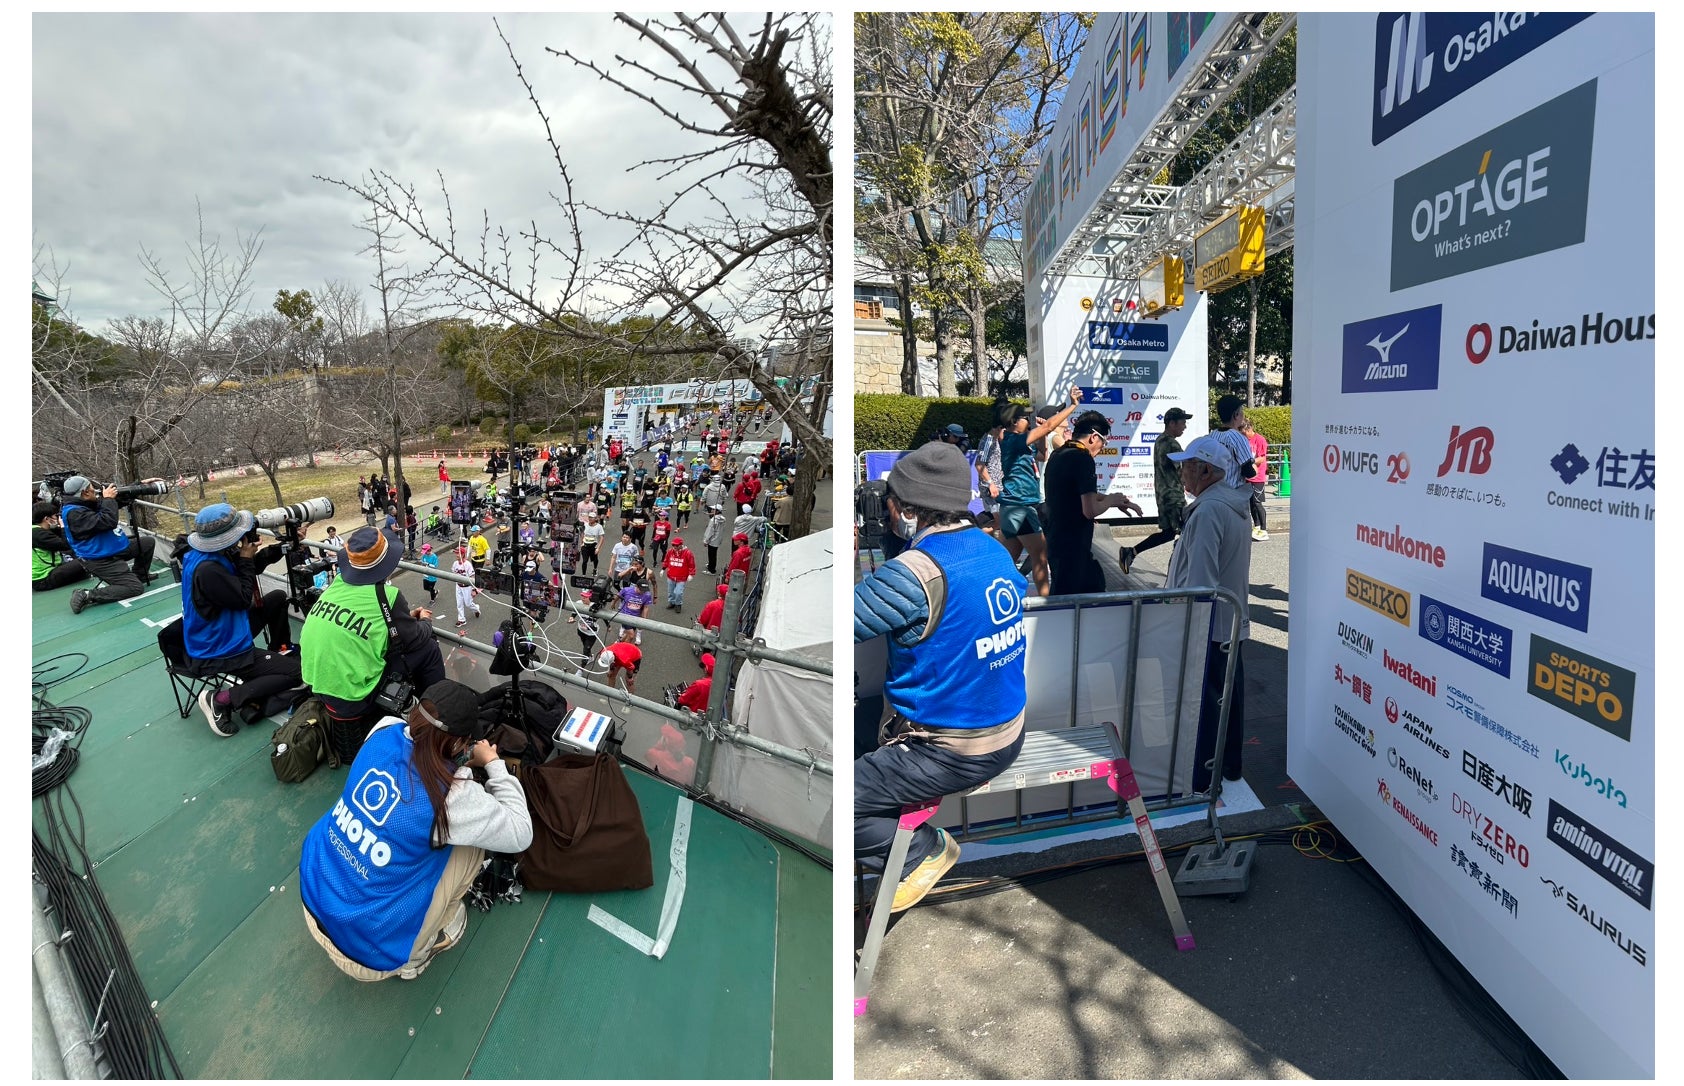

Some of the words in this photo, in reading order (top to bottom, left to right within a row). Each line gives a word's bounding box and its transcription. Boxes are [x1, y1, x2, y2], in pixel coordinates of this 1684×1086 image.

[1411, 146, 1550, 242] OPTAGE
[1434, 234, 1472, 258] What's
[1474, 219, 1512, 247] next?
[1202, 256, 1230, 286] SEIKO
[1116, 338, 1142, 347] Osaka
[1142, 339, 1166, 348] Metro
[1499, 319, 1577, 354] Daiwa
[1110, 363, 1151, 376] OPTAGE
[1364, 362, 1408, 381] MIZUNO
[1125, 411, 1143, 423] JTB
[1342, 450, 1378, 475] MUFG
[1386, 451, 1411, 484] 20
[1437, 425, 1494, 478] JTB
[1426, 483, 1507, 508] 感動のそばに、いつも。
[1547, 490, 1603, 513] Connect
[1608, 500, 1640, 519] with
[1357, 523, 1446, 568] marukome
[1347, 572, 1408, 620] SEIKO
[1488, 558, 1580, 612] AQUARIUS
[311, 599, 373, 641] OFFICIAL
[1447, 615, 1503, 655] 関西大学
[1447, 636, 1468, 652] KANSAI
[1467, 646, 1502, 667] UNIVERSITY
[1550, 652, 1611, 687] SPORTS
[1334, 663, 1373, 705] 丸一鋼管
[1383, 648, 1436, 698] Iwatani
[1535, 662, 1623, 722] DEPO
[1446, 683, 1474, 704] KOSMO
[1334, 716, 1361, 745] LOGISTICS
[1402, 709, 1433, 735] JAPAN
[1403, 722, 1451, 760] AIRLINES
[1462, 749, 1533, 819] 日産大阪
[1555, 748, 1628, 809] Kubota
[331, 797, 392, 867] PHOTO
[1393, 796, 1438, 848] RENAISSANCE
[1452, 792, 1482, 829] DRY
[1483, 816, 1529, 868] ZERO
[1471, 830, 1504, 865] ドライゼロ
[1552, 816, 1603, 861] amino
[1601, 847, 1644, 890] VITAL
[1566, 890, 1647, 968] SAURUS
